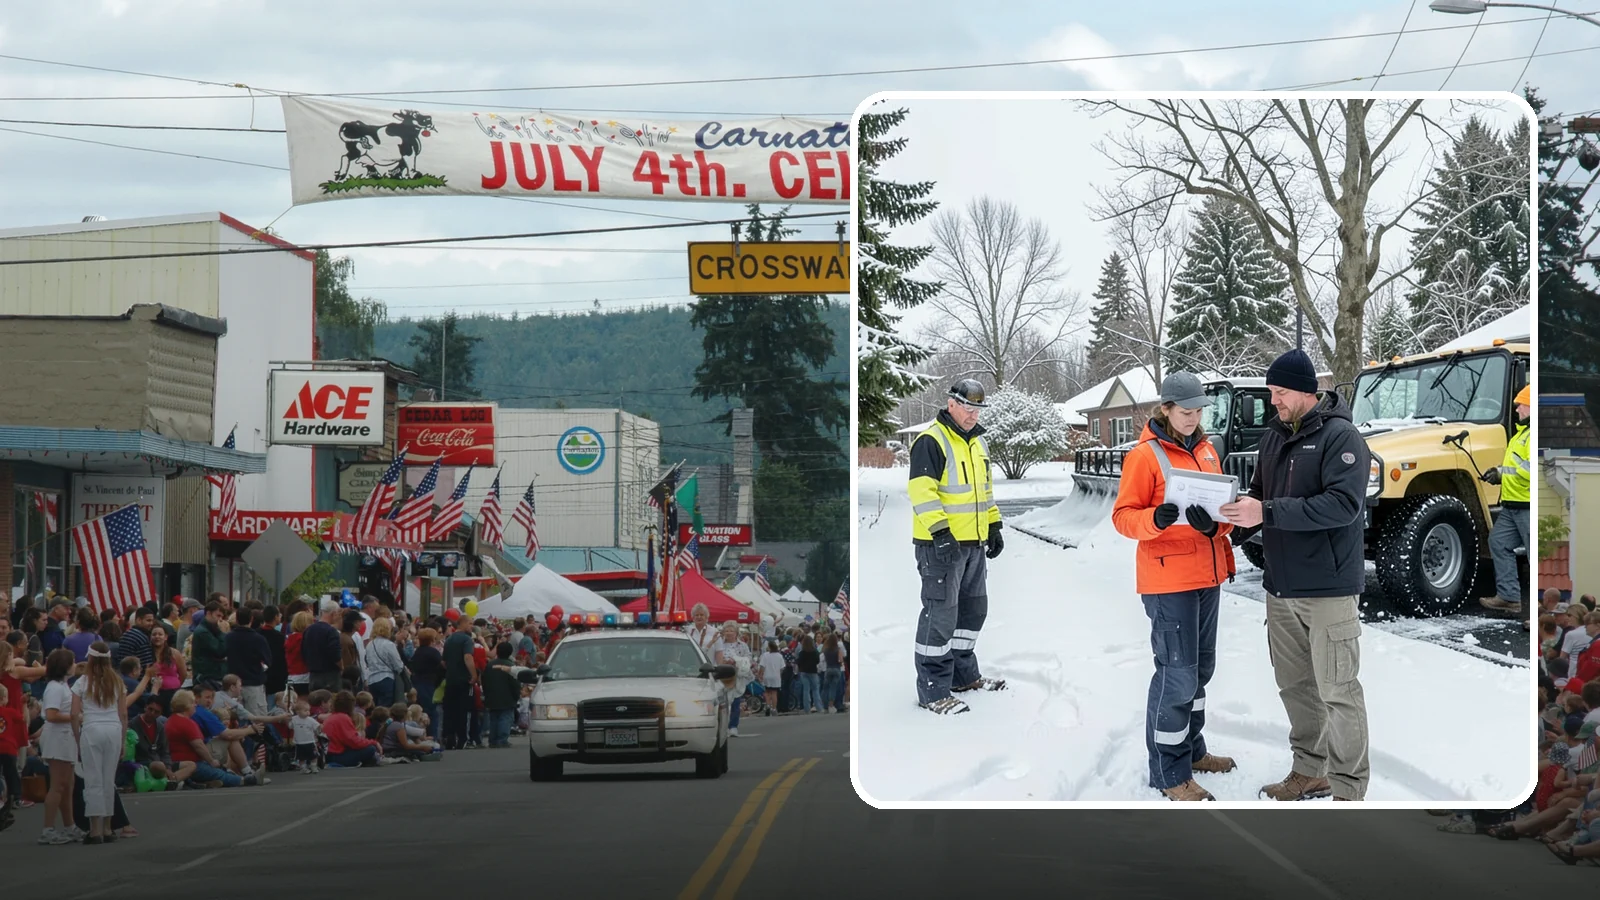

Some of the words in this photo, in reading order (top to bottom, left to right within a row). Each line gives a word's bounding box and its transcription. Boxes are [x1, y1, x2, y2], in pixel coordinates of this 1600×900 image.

[481, 140, 606, 193] JULY
[632, 150, 747, 198] 4th.
[696, 254, 850, 280] CROSSWA
[282, 380, 374, 420] ACE
[405, 409, 453, 422] CEDAR
[461, 409, 486, 422] LOG
[283, 421, 371, 436] Hardware
[416, 428, 477, 447] Coca-Cola
[96, 485, 124, 494] Vincent
[126, 486, 136, 495] de
[137, 486, 155, 495] Paul
[212, 516, 331, 535] HARDARE
[688, 526, 742, 535] CRNATION
[699, 535, 730, 543] GLASS
